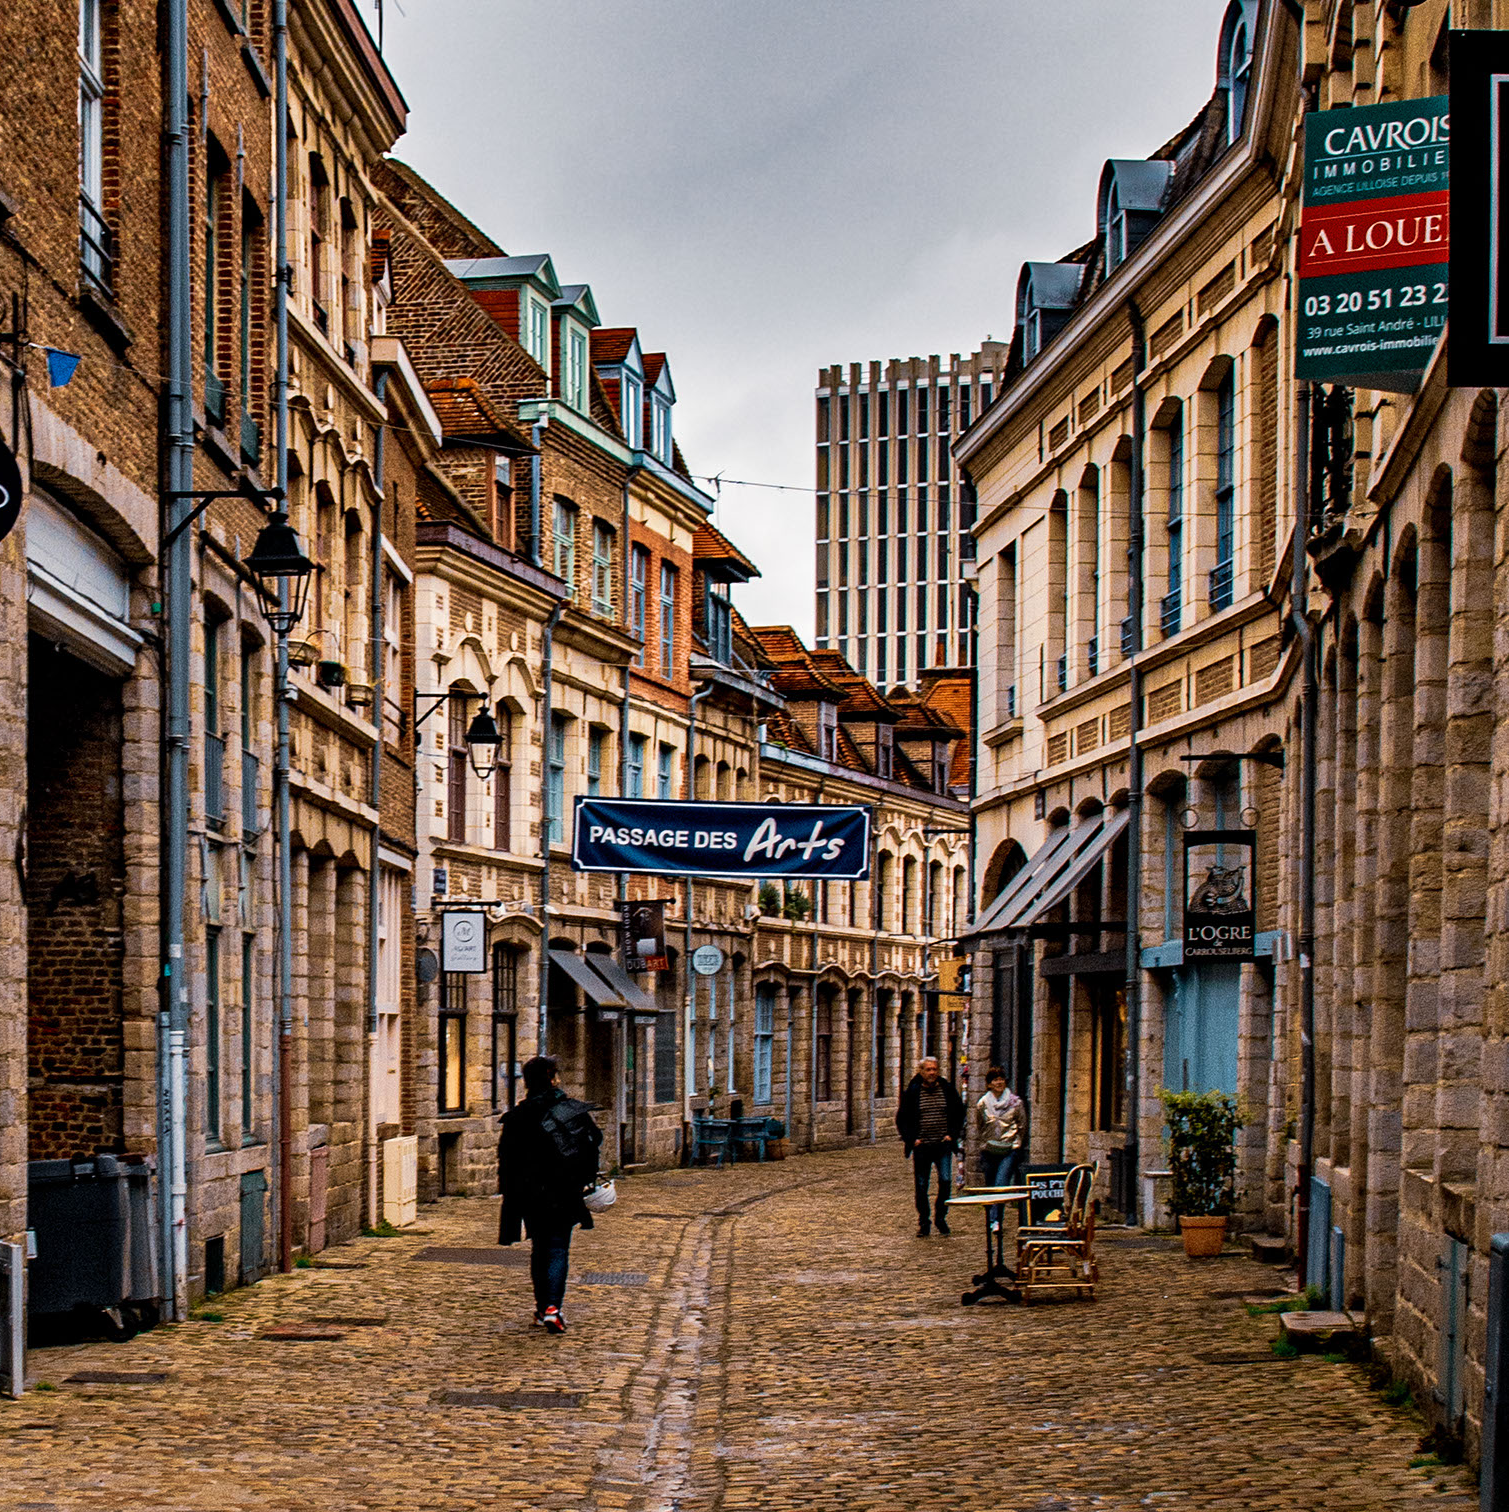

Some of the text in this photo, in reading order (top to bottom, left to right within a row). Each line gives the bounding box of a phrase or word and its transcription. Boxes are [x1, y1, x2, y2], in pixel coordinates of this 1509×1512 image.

[1313, 150, 1445, 179] IMMOBILIE
[1312, 182, 1354, 197] AGENCE
[1356, 178, 1398, 191] LILLOISE
[1401, 172, 1438, 186] DEPUIS
[1308, 214, 1449, 257] A LOUE
[1304, 282, 1449, 316] 03 20 51 23 2
[1307, 327, 1322, 339] 39
[1324, 327, 1343, 336] rue
[1346, 322, 1376, 335] Saint
[1378, 317, 1414, 332] André
[1303, 335, 1439, 357] www.cavrois-immobilie
[589, 817, 845, 862] PASSAGE DES Arts
[1188, 925, 1252, 941] L'OGRE
